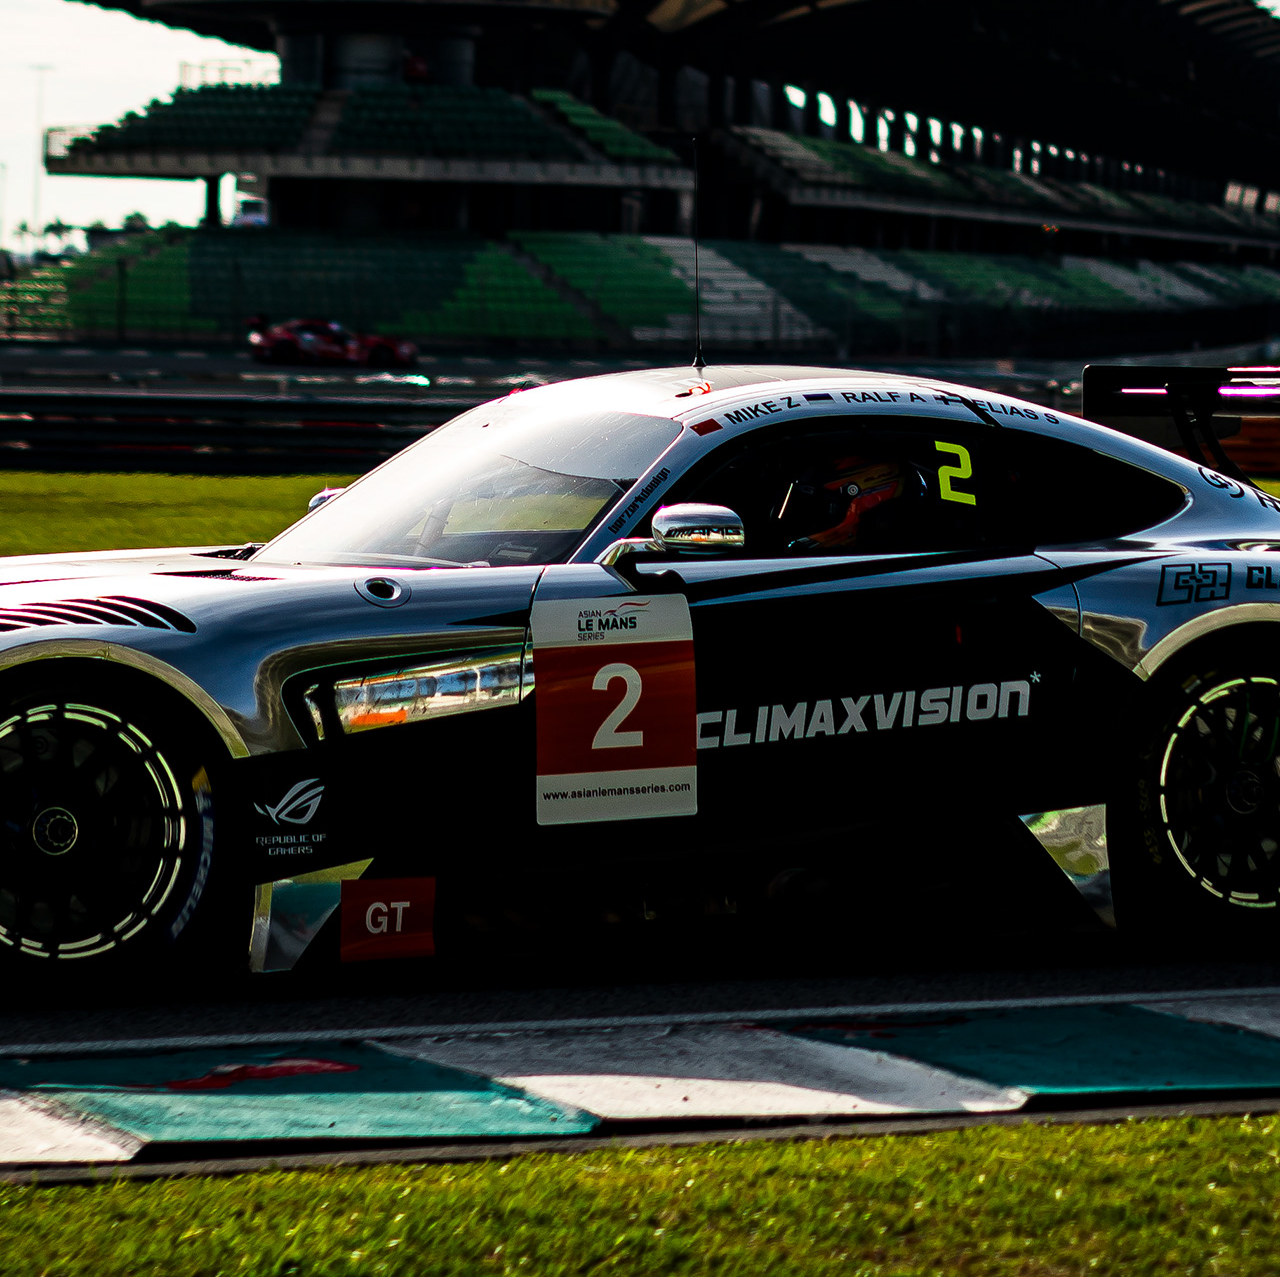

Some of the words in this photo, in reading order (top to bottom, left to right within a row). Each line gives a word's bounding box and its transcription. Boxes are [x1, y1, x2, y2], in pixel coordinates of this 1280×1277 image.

[840, 390, 900, 404] RALF
[908, 391, 926, 403] A
[723, 401, 782, 425] MIKE
[782, 396, 801, 412] Z
[975, 399, 1039, 420] ELIAS
[1044, 410, 1060, 425] S
[934, 440, 978, 506] 2
[578, 609, 602, 619] ASIAN
[577, 618, 594, 632] LE
[597, 616, 637, 631] MANS
[577, 631, 605, 642] SERIES
[591, 662, 644, 750] 2
[696, 679, 1031, 750] CLIMAXVISION
[542, 782, 691, 801] www.asianlemansseries.com
[255, 833, 310, 847] REPUBLIC
[311, 833, 327, 843] OF
[268, 845, 313, 856] GAMERS
[364, 900, 411, 934] GT
